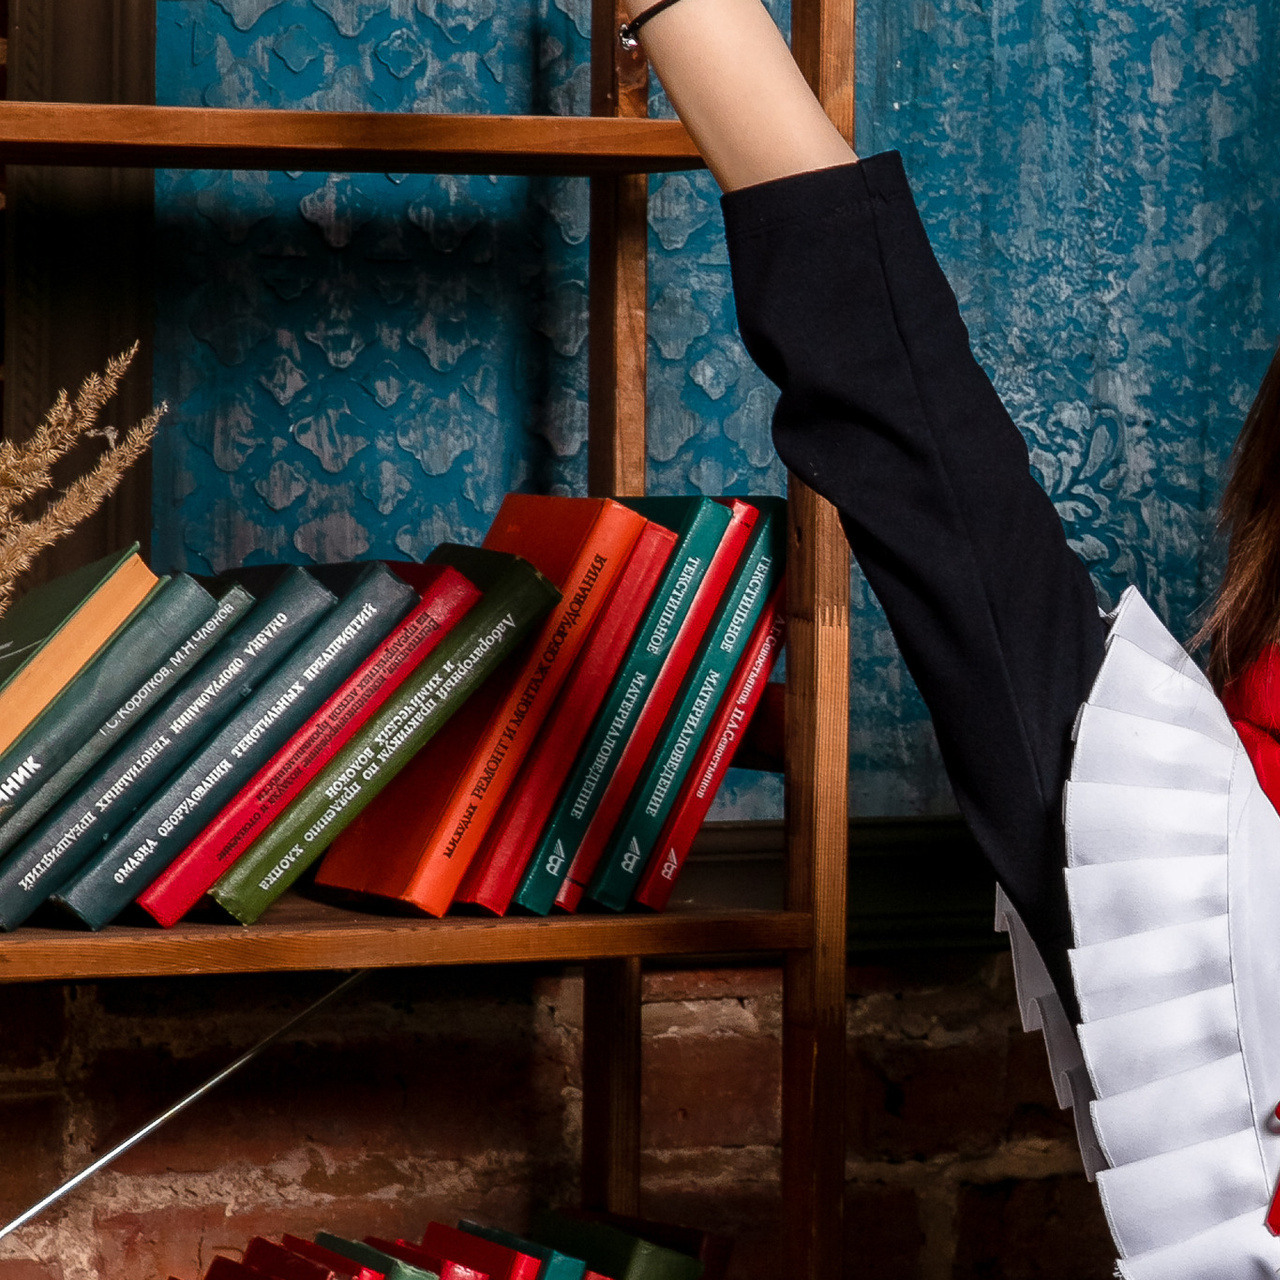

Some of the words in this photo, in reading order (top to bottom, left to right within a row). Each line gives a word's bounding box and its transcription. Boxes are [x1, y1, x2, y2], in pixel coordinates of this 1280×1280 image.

[242, 612, 287, 656] СМАЗКА
[540, 553, 607, 666] ОБОРУДОВАНИЯ
[646, 556, 701, 654] ТЕКСТИЛЬНОЕ
[719, 555, 770, 653] ТЕКСТИЛЬНОЕ
[430, 613, 515, 700] Лабораторный
[441, 659, 455, 672] и
[509, 660, 552, 727] МОНТАЖ
[169, 657, 245, 734] ОБОРУДОВАНИЯ
[371, 697, 437, 763] практикум
[373, 672, 443, 746] химических
[502, 724, 517, 741] И
[94, 734, 171, 812] ТЕКСТИЛЬНЫХ
[113, 837, 158, 883] СМАЗКА
[157, 757, 233, 836] ОБОРУДОВАНИЯ
[230, 679, 305, 758] ТЕКСТИЛЬНЫХ
[302, 602, 377, 681] ПРЕДПРИЯТИЙ
[323, 746, 374, 799] волокон
[361, 761, 380, 780] по
[470, 737, 512, 800] РЕМОНТ
[570, 670, 647, 819] МАТЕРИАЛОВЕДЕНИЕ
[645, 668, 721, 816] МАТЕРИАЛОВЕДЕНИЕ
[303, 780, 361, 841] прядению
[17, 810, 97, 890] ПРЕДПРИЯТИЙ
[258, 842, 304, 890] хлопка
